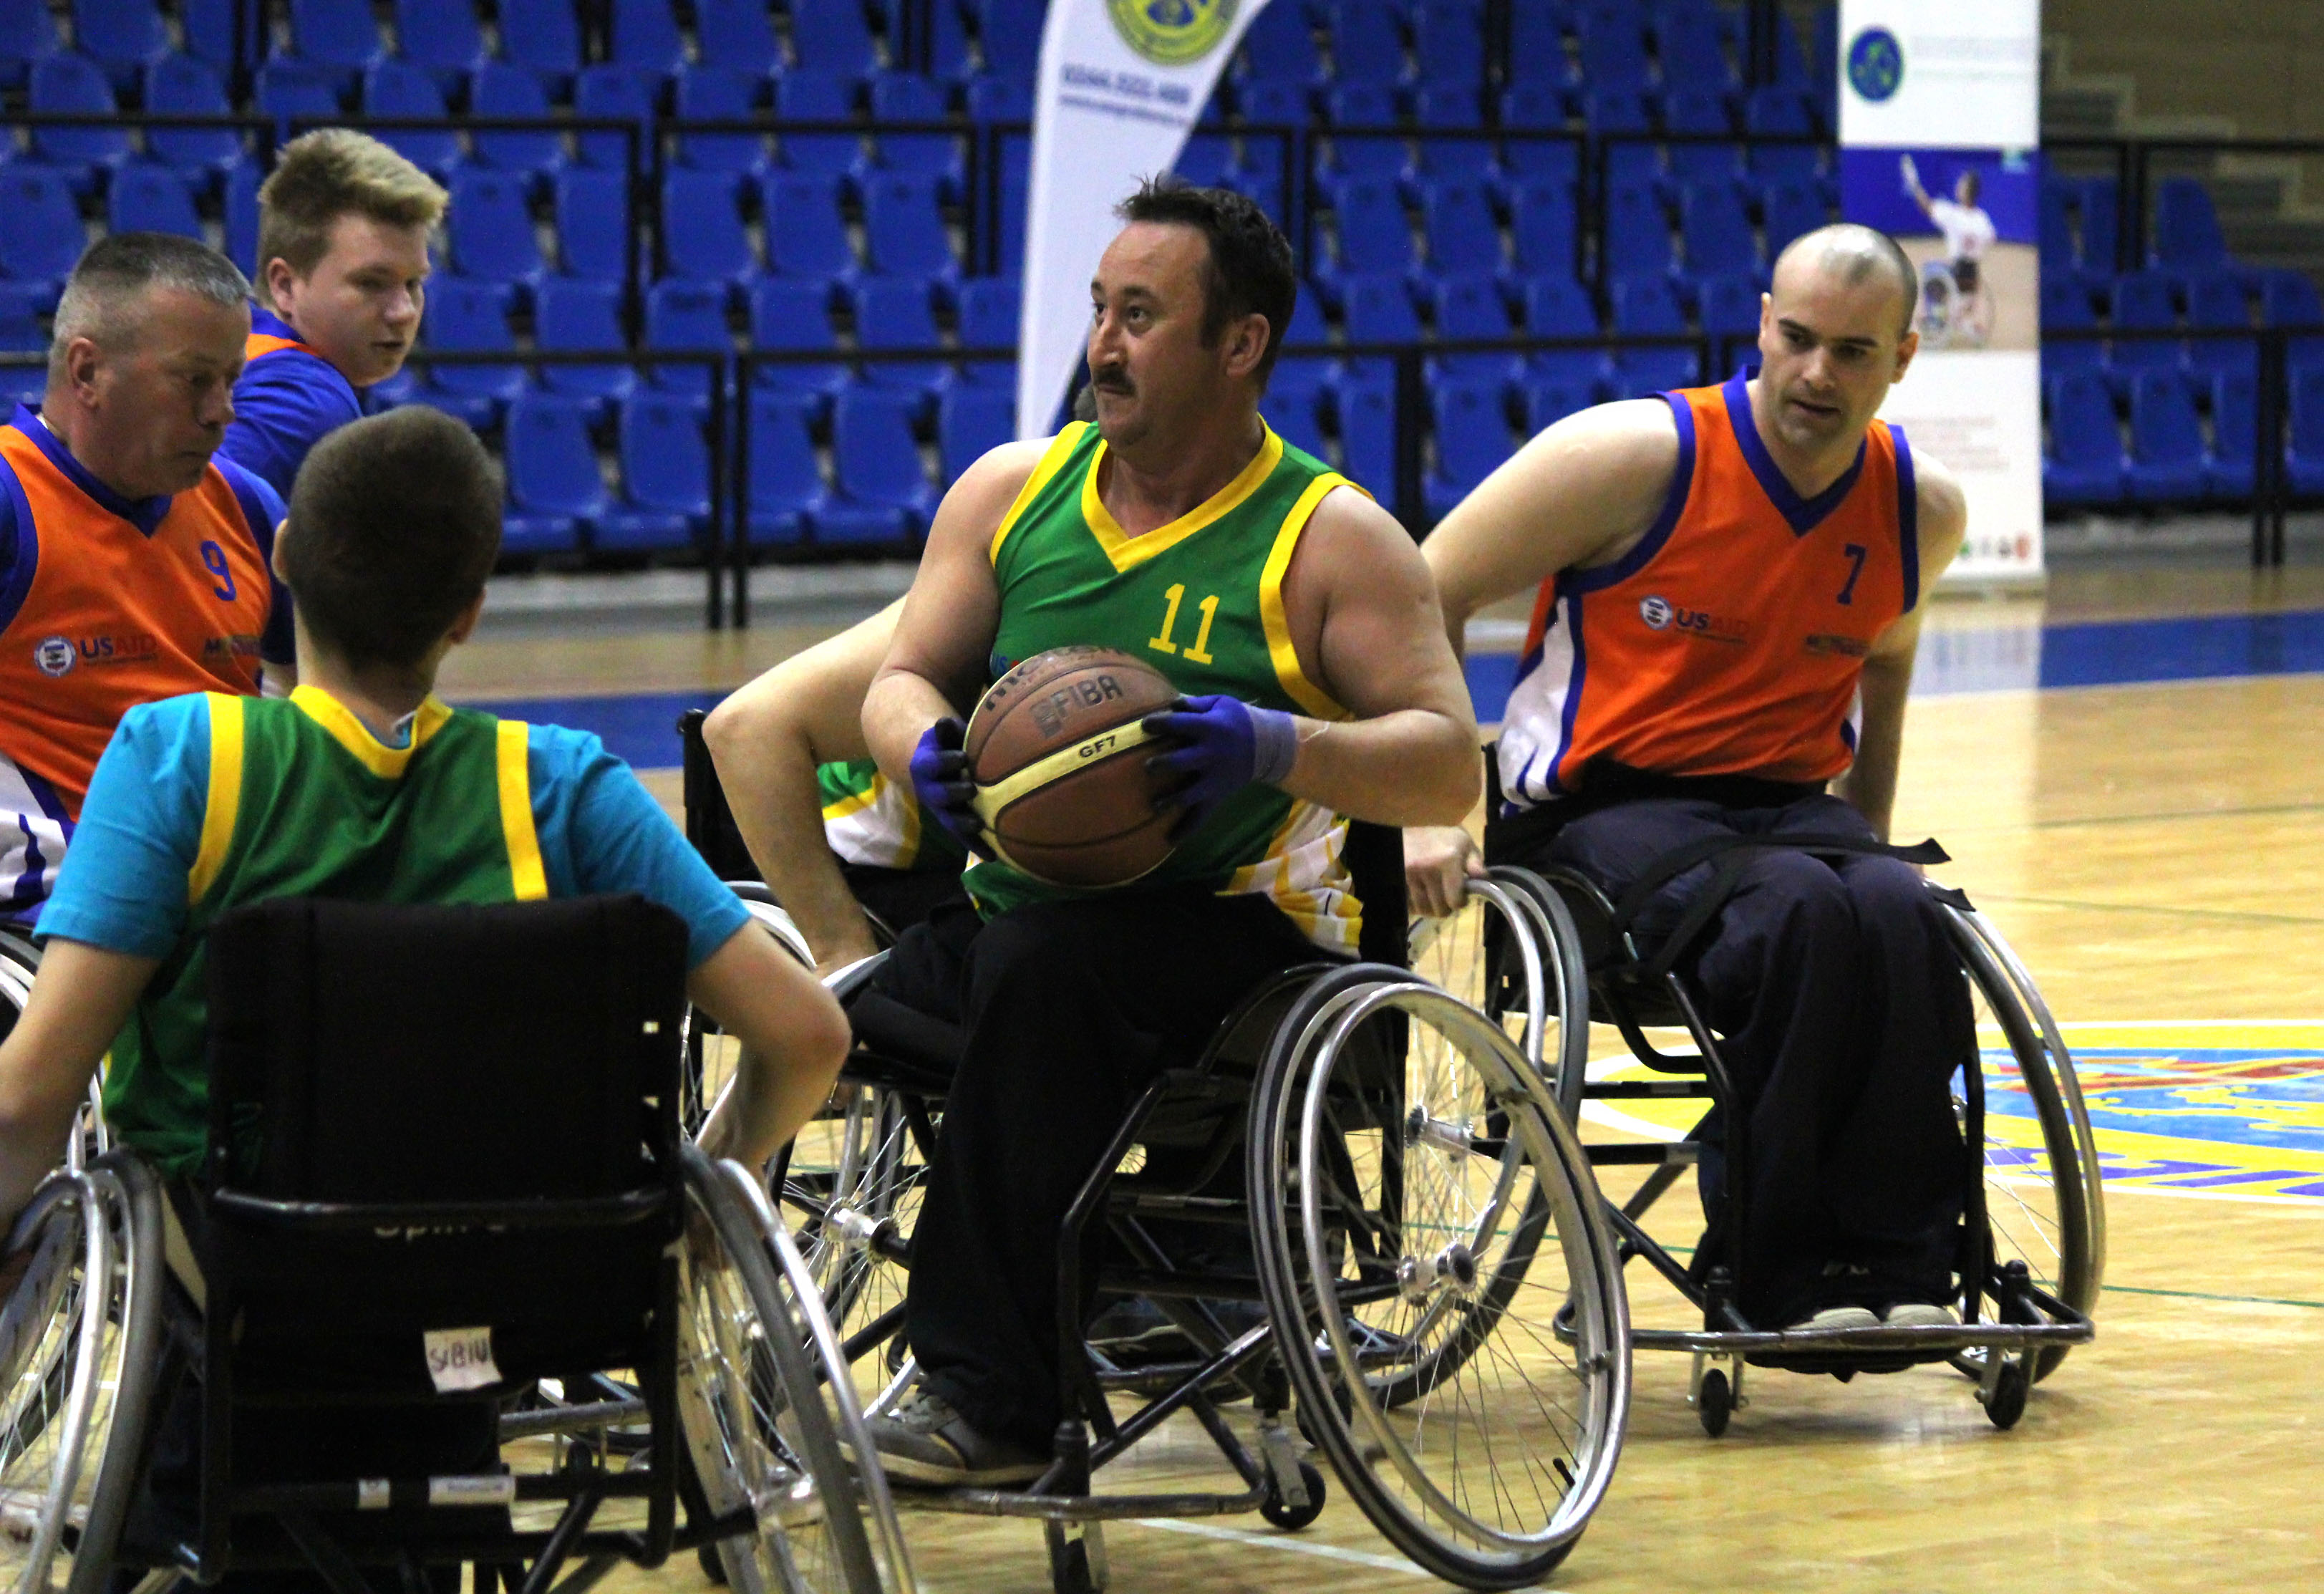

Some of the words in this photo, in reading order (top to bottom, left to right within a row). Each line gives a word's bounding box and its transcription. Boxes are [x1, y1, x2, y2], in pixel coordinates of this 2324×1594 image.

[200, 540, 236, 602] 9
[1836, 543, 1867, 605] 7
[1148, 583, 1220, 665] 11
[1050, 674, 1123, 720] FIBA
[1079, 735, 1117, 758] GF7
